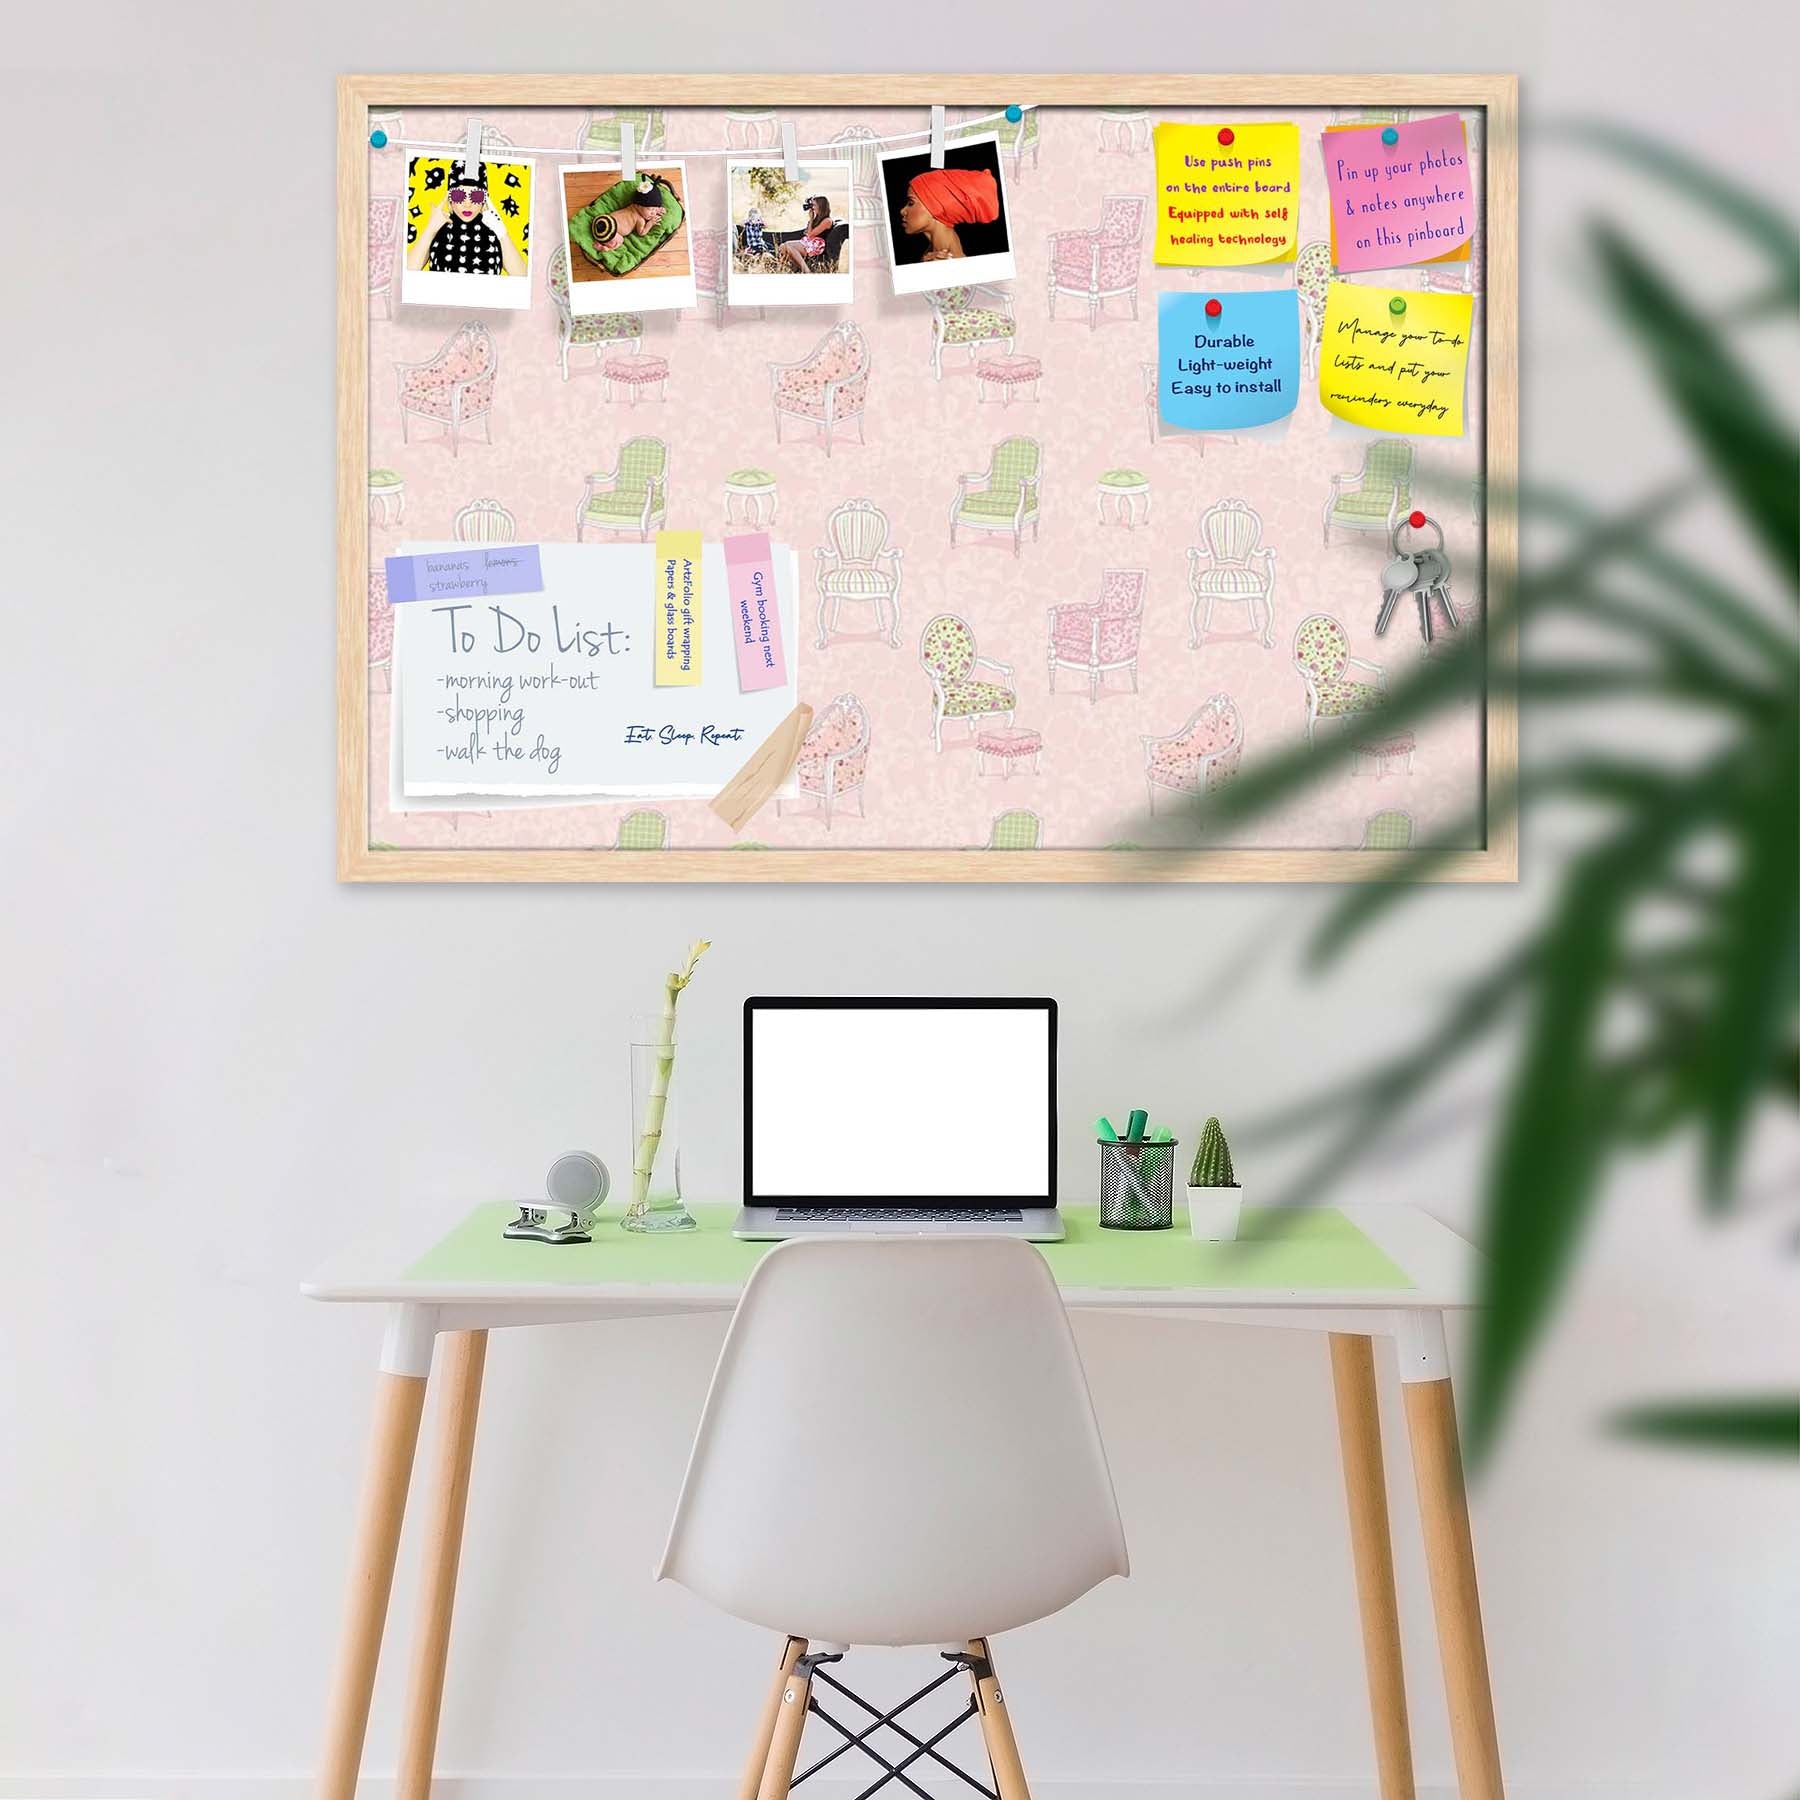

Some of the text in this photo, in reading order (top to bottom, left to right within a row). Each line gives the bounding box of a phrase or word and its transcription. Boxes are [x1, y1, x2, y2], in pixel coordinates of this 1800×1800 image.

[1185, 155, 1272, 171] Use push pins
[1337, 149, 1463, 182] Pin up your photos
[1166, 181, 1290, 194] on the entire board
[1346, 185, 1464, 215] & notes anywhere
[1168, 206, 1288, 223] Equipped with self
[1171, 234, 1286, 247] healing technology
[1356, 216, 1464, 249] on this pinboard
[1195, 334, 1254, 348] Durable
[1338, 318, 1396, 344] Manage
[1399, 332, 1427, 347] your
[1178, 357, 1272, 374] Light-weight
[1369, 361, 1396, 374] and
[1398, 363, 1424, 380] put
[1421, 369, 1450, 383] your
[1172, 379, 1281, 397] Easy to install
[1331, 393, 1449, 419] reminders everyday
[426, 560, 469, 573] bananas
[429, 577, 488, 595] strawberry
[665, 559, 677, 659] Papers & glass boards
[681, 559, 694, 671] ArtzFolio gift wrapping
[740, 600, 756, 644] weekend
[752, 571, 775, 667] Gym booking next
[432, 605, 631, 657] To Do List:
[437, 662, 600, 703] -morning work-out
[437, 693, 525, 735] -shopping
[659, 725, 695, 745] Sleep.
[701, 725, 744, 745] Repeat.
[437, 732, 561, 774] -walk the dog
